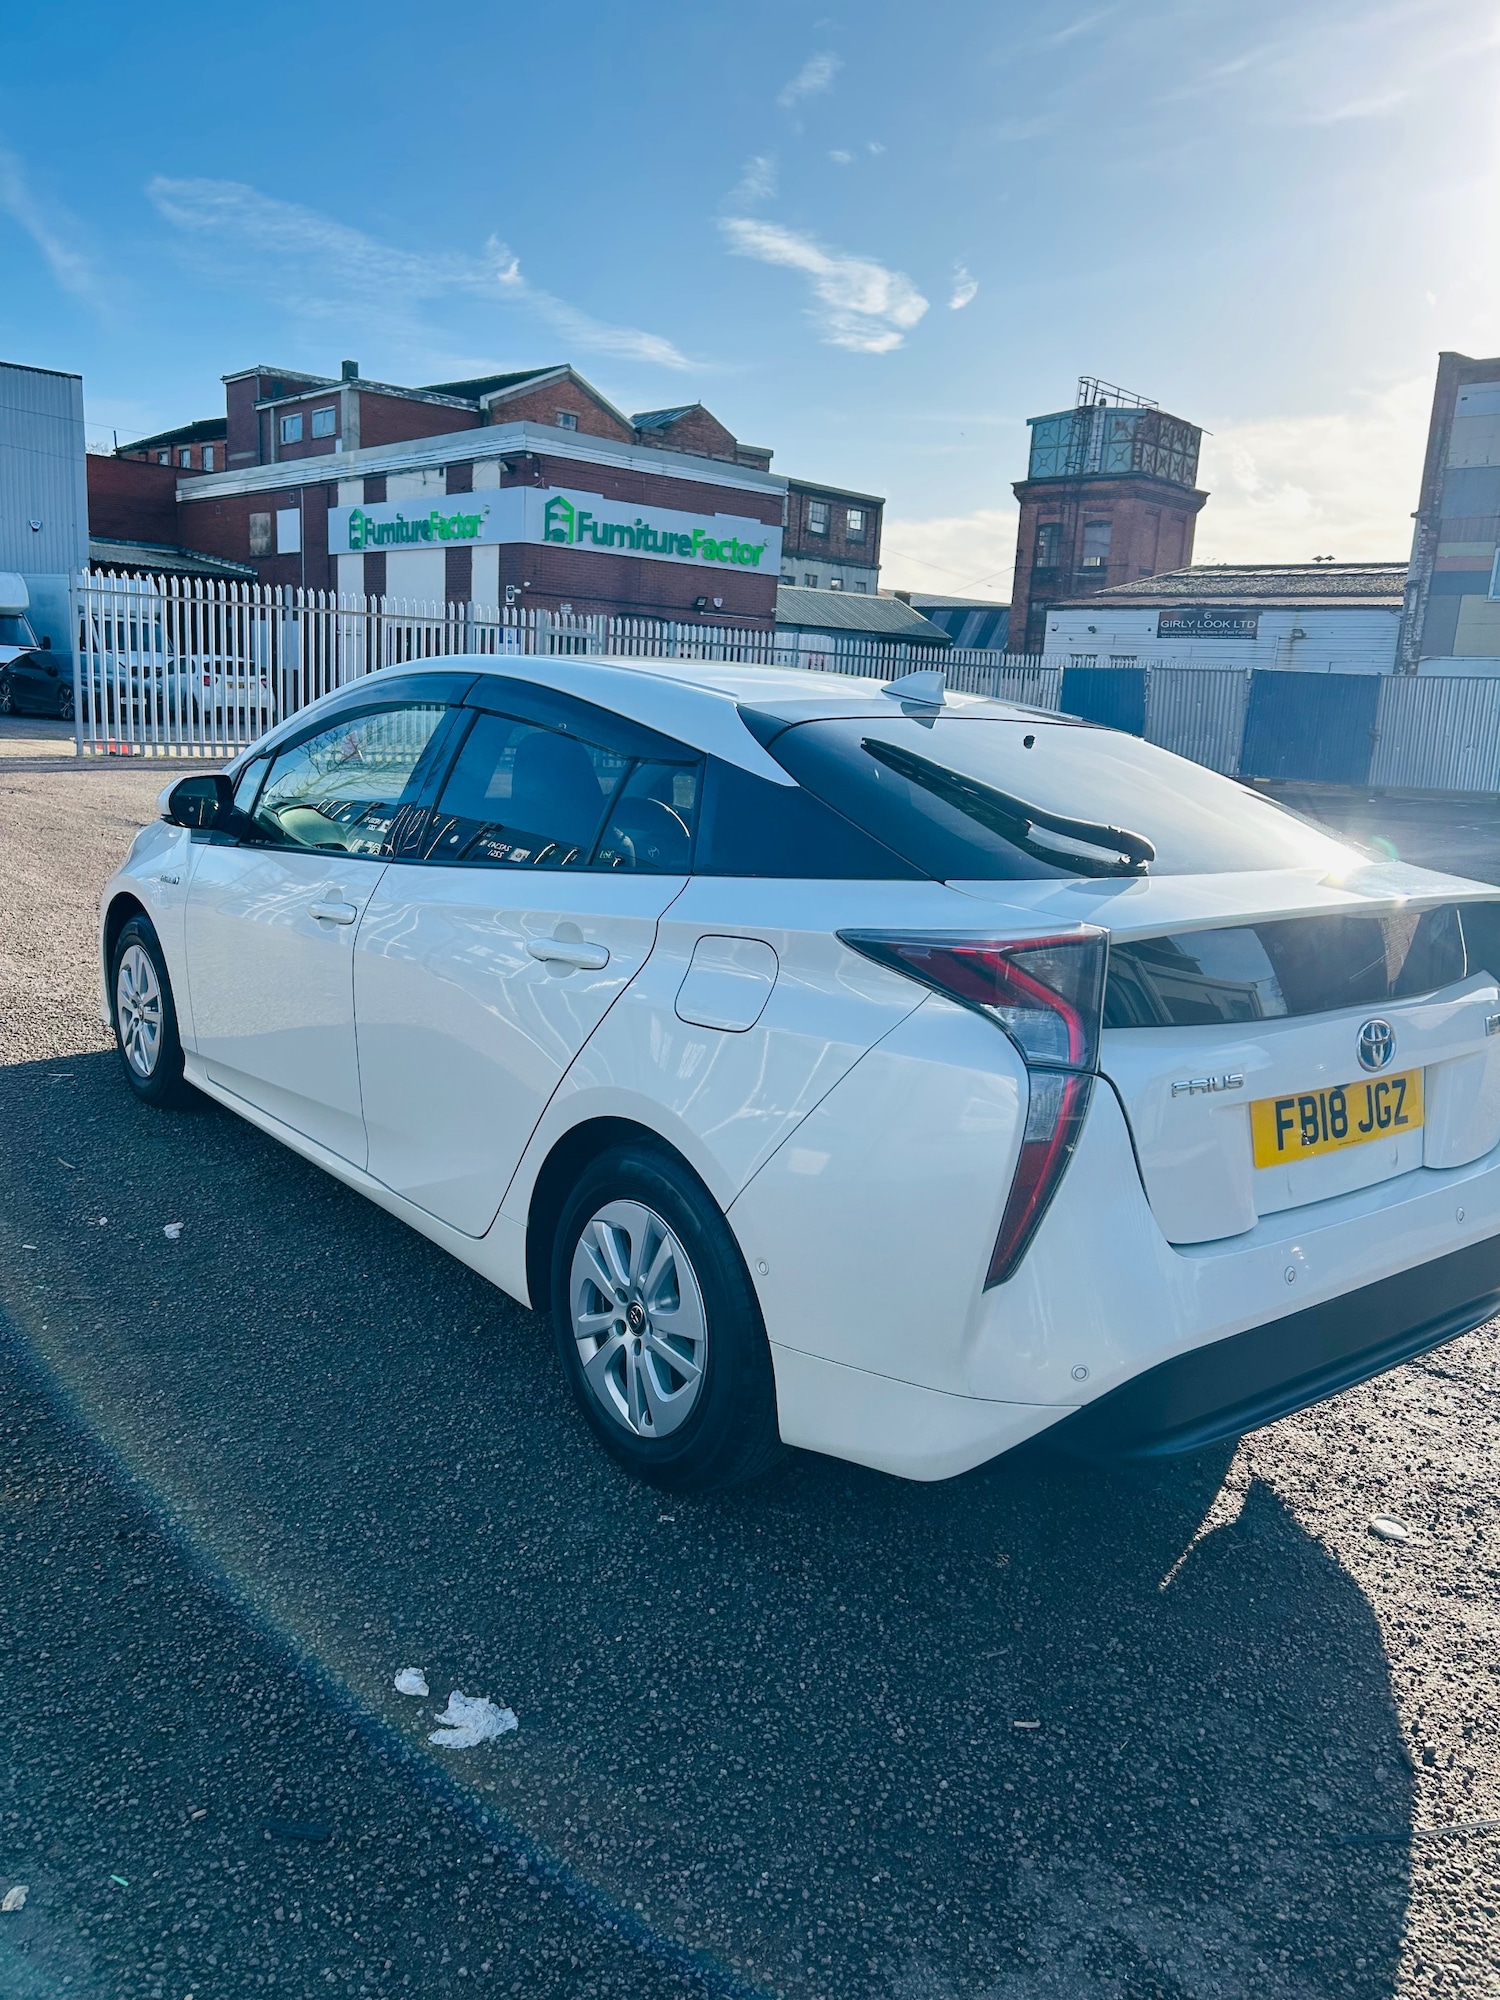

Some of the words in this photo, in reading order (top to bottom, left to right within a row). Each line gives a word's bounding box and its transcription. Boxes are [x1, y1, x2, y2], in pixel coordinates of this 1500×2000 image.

[365, 511, 482, 545] FurnitureFactor
[577, 511, 765, 566] FurnitureFactor
[1161, 620, 1195, 628] GIRLY
[1197, 620, 1230, 628] LOOK
[1233, 620, 1256, 628] LTD
[1171, 1073, 1244, 1098] PRIUS
[1275, 1089, 1349, 1151] FB18
[1358, 1078, 1409, 1133] JGZ
